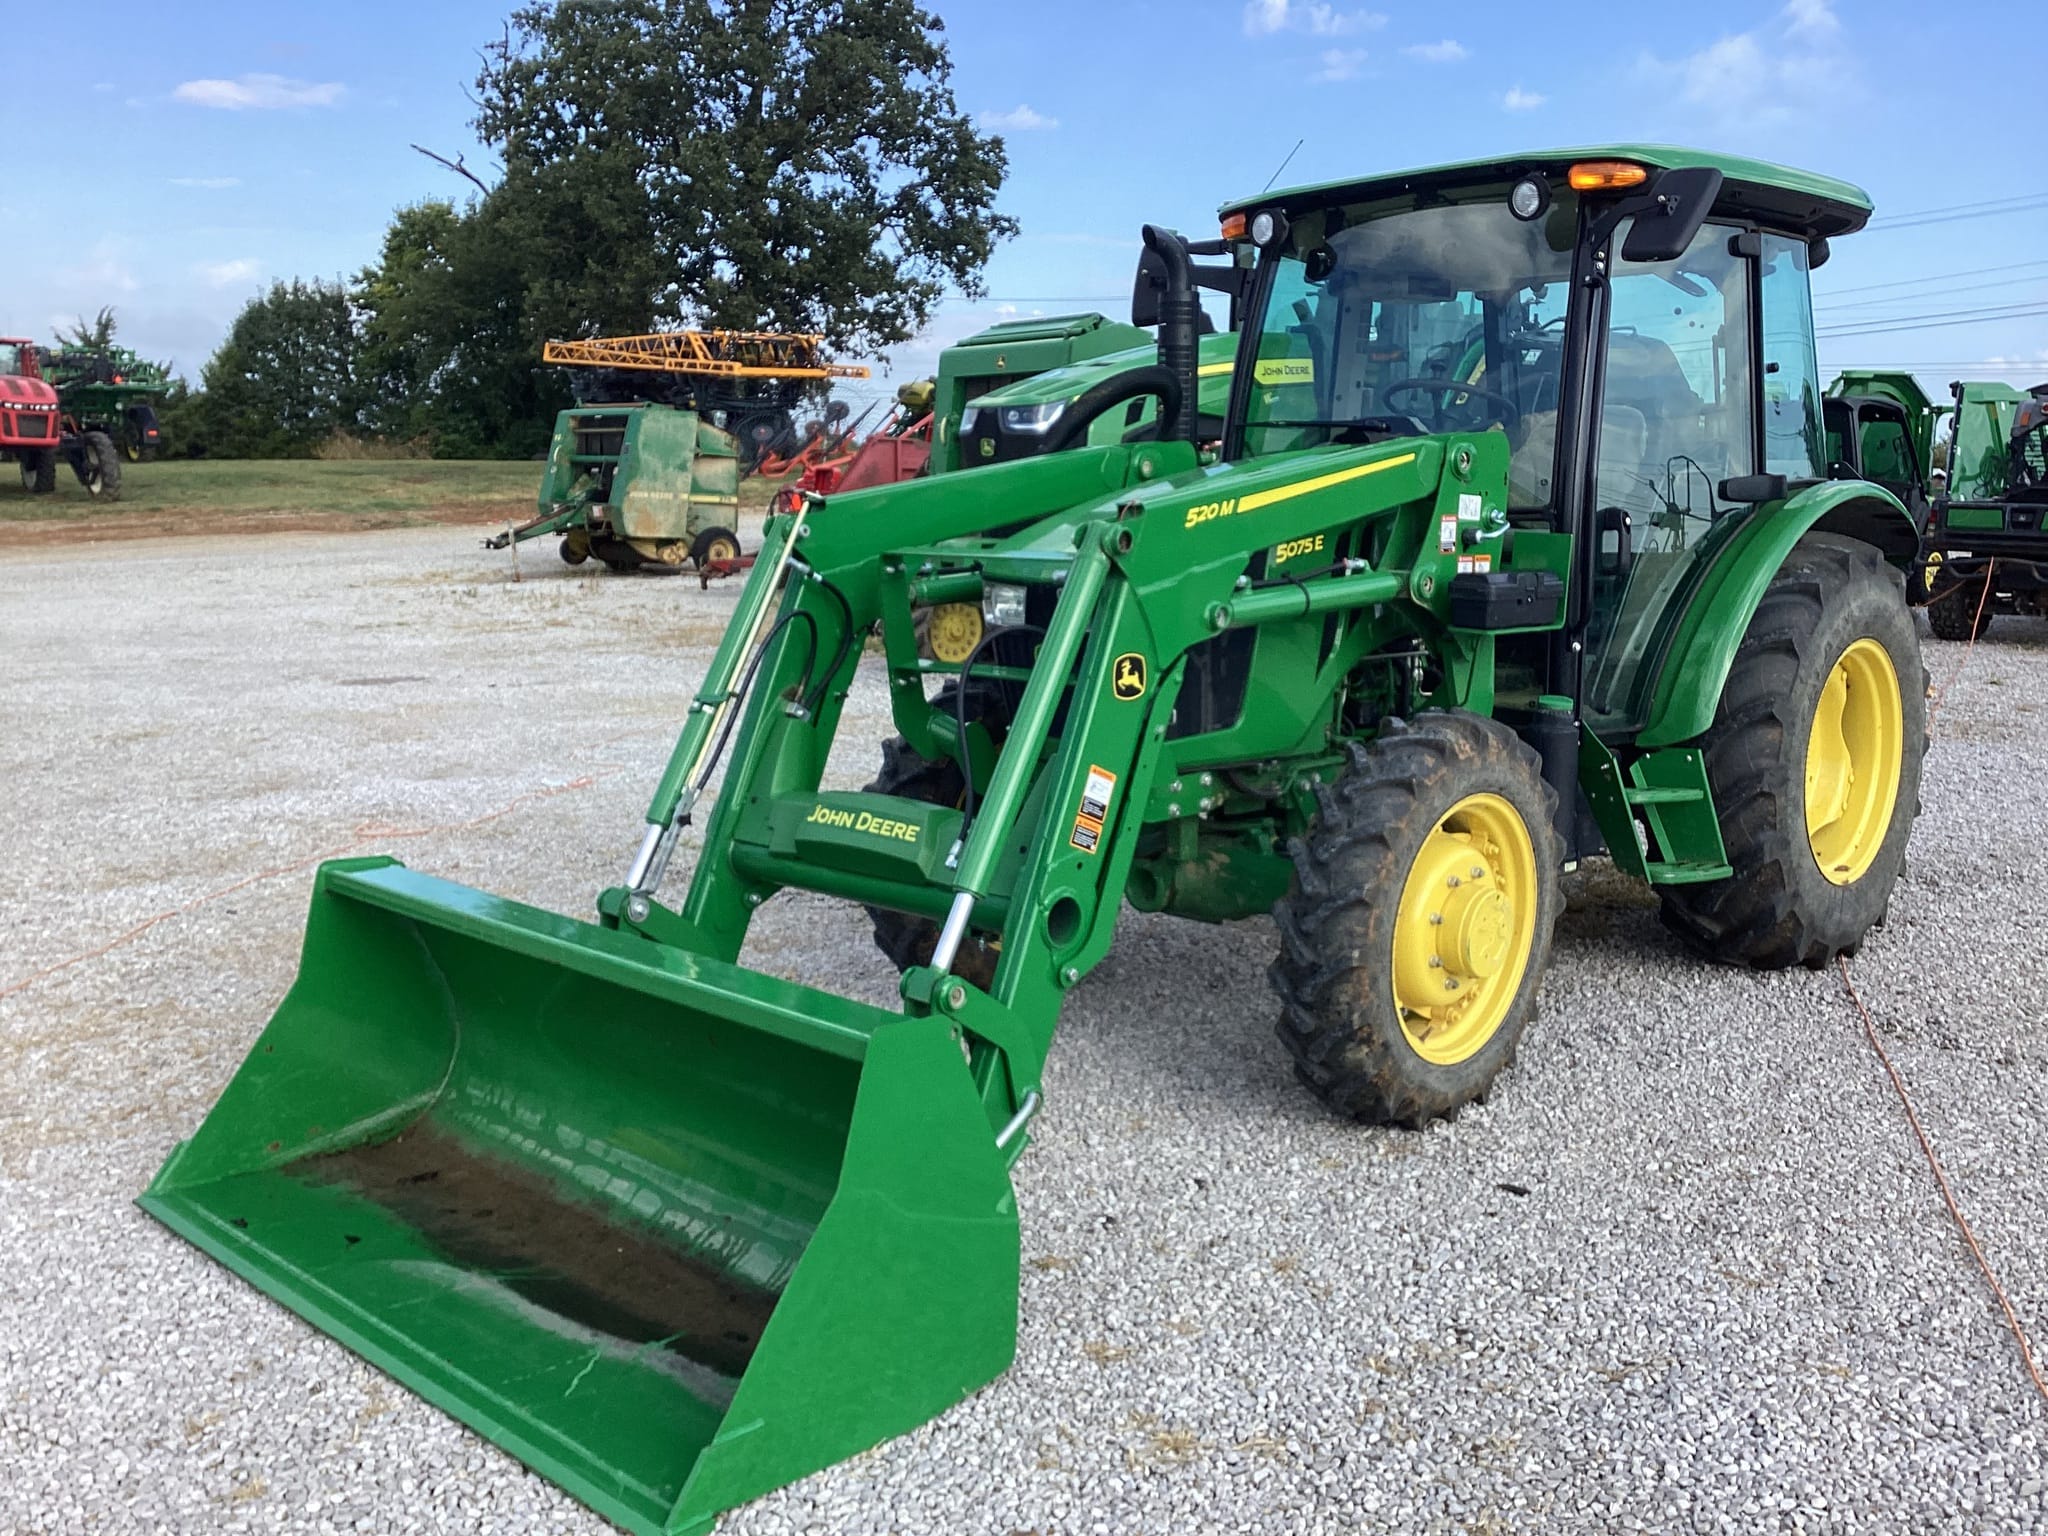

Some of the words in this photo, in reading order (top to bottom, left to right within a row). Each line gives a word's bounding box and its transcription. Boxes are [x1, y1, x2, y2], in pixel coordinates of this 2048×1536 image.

[1261, 365, 1284, 376] JOHN
[1284, 364, 1310, 375] DEERE
[807, 804, 856, 829] JOHN
[855, 811, 921, 842] DEERE
